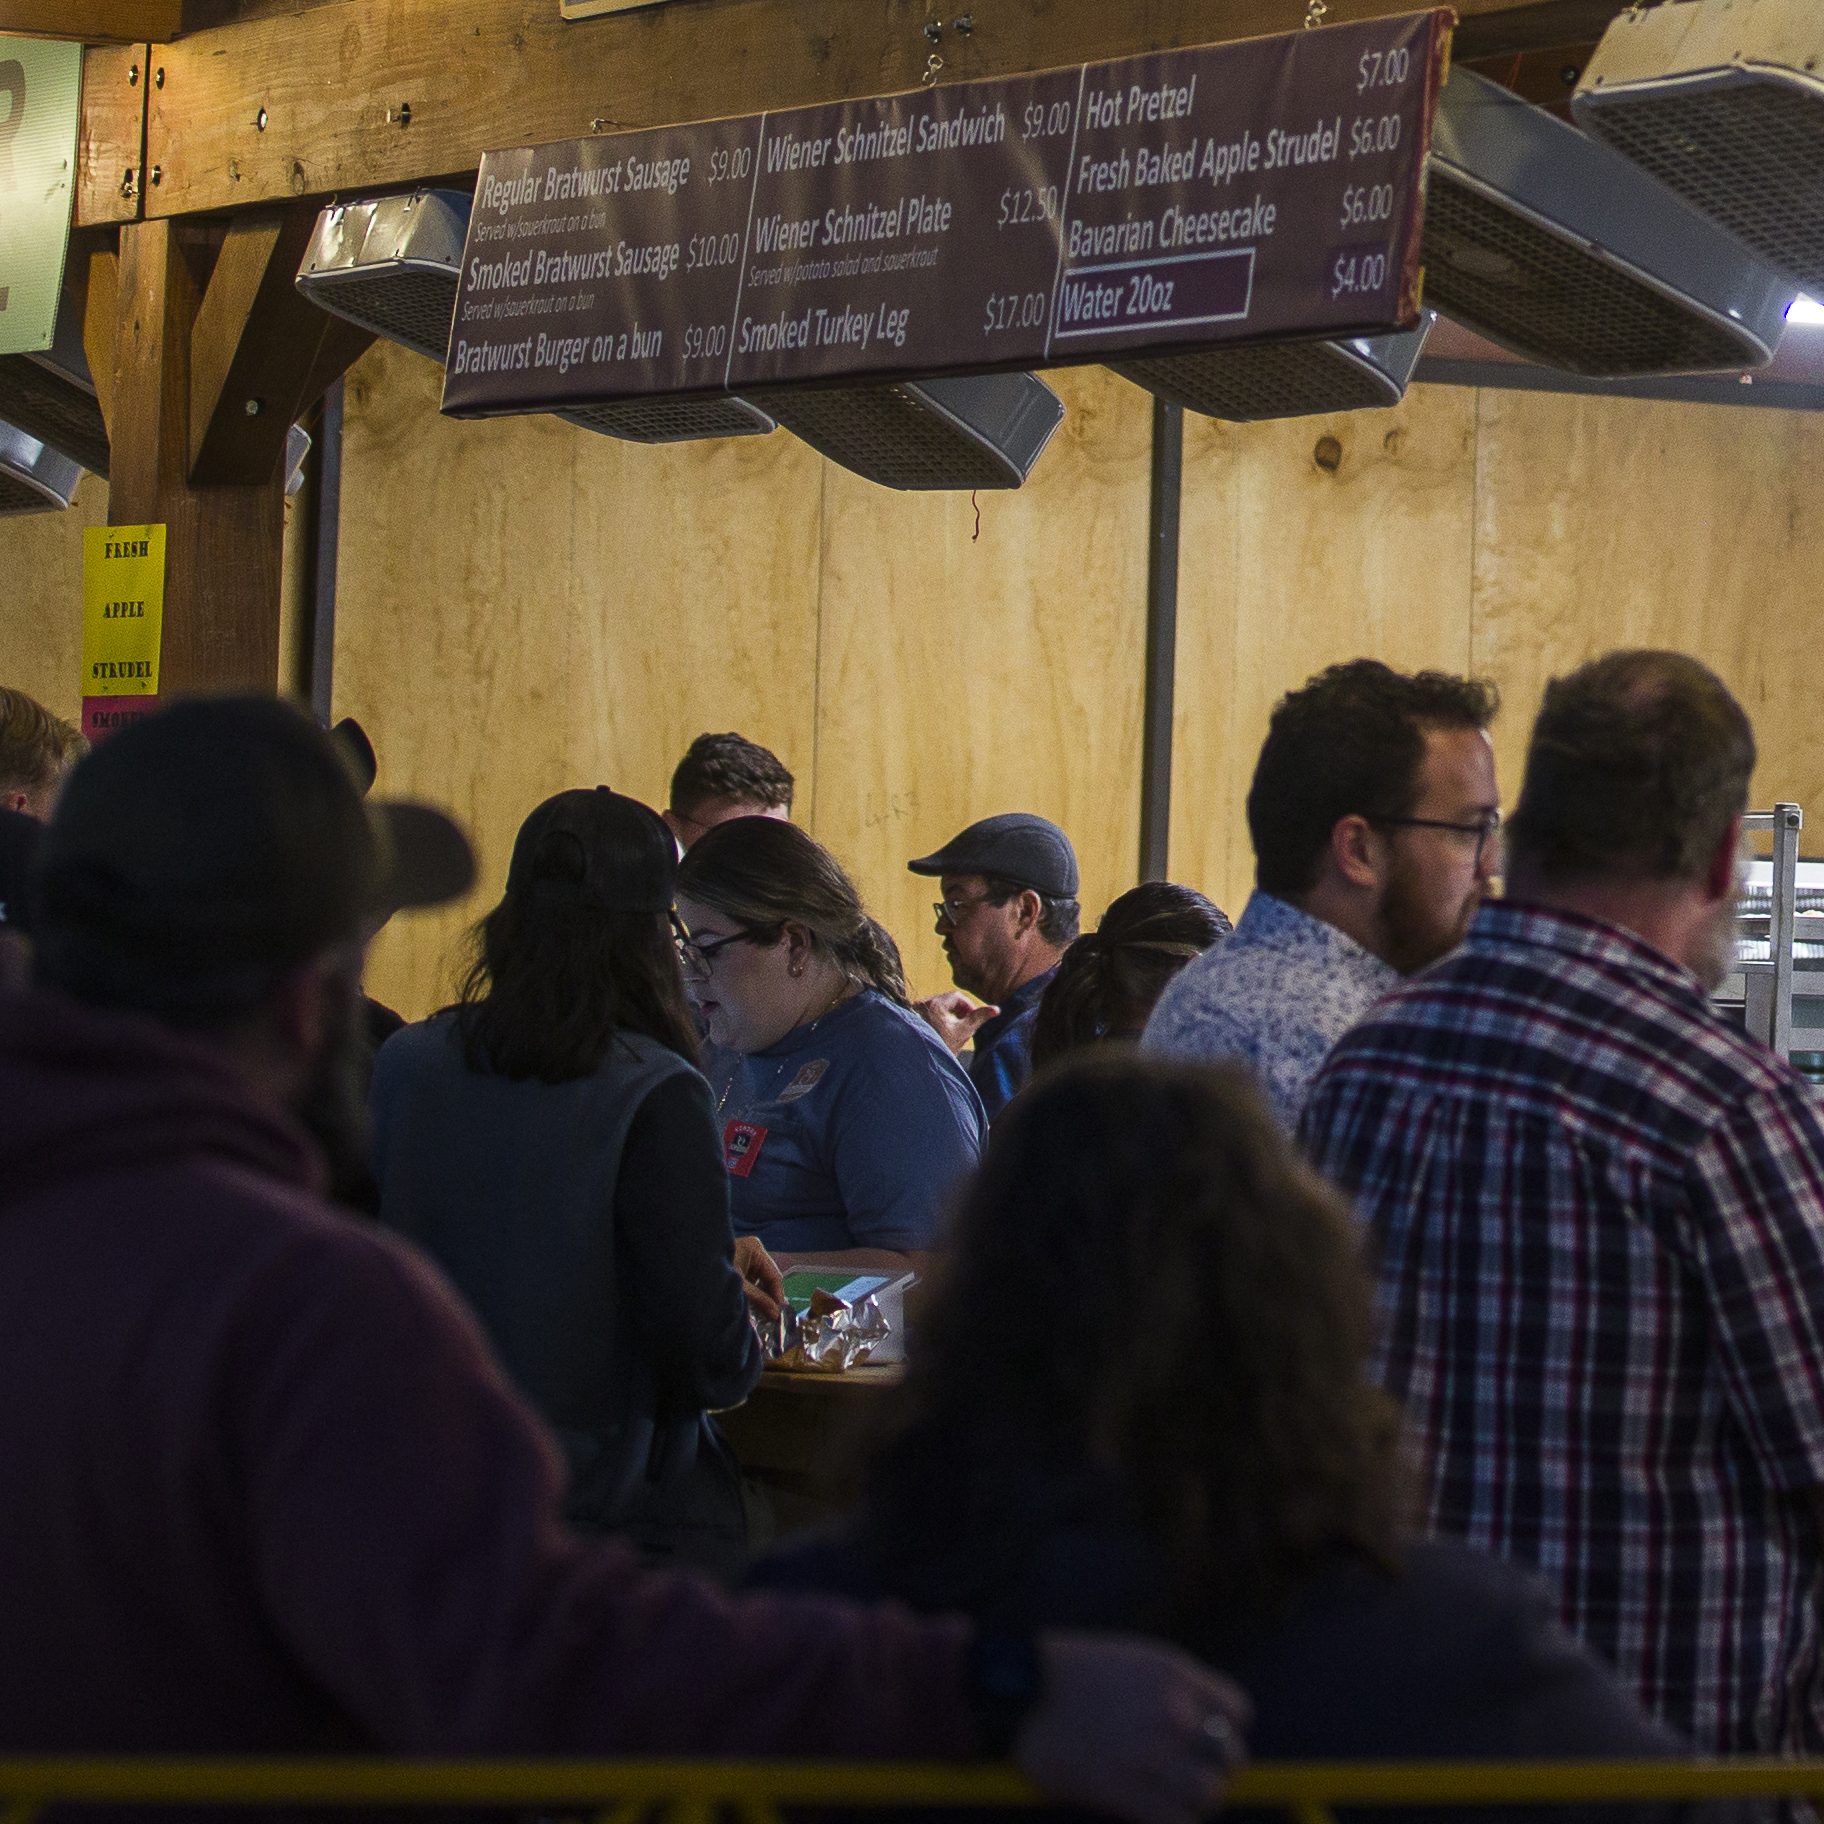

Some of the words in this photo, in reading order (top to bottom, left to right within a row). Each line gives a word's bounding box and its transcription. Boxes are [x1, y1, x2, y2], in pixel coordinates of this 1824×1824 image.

[1086, 90, 1123, 129] Hot
[1126, 74, 1197, 125] Pretzel
[1357, 48, 1410, 95] $7.00
[767, 133, 832, 173] Wiener
[834, 115, 915, 165] Schnitzel
[916, 102, 1006, 152] Sandwich
[1022, 100, 1071, 141] $9.00
[1078, 149, 1130, 194] Fresh
[1134, 138, 1198, 186] Baked
[1199, 130, 1260, 186] Apple
[1264, 115, 1342, 170] Strudel
[1348, 114, 1401, 159] $6.00
[482, 169, 542, 215] Regular
[544, 161, 621, 201] Bratwurst
[624, 156, 690, 195] Sausage
[708, 147, 750, 186] $9.00
[475, 220, 506, 243] Served
[755, 214, 819, 253] Wiener
[822, 196, 904, 246] Schnitzel
[907, 195, 952, 235] Plate
[998, 185, 1058, 231] $12.50
[1068, 213, 1154, 258] Bavarian
[1159, 193, 1277, 248] Cheesecake
[1340, 183, 1393, 231] $6.00
[467, 250, 532, 291] Smoked
[534, 244, 613, 285] Bratwurst
[615, 241, 680, 280] Sausage
[686, 233, 739, 273] $10.00
[747, 261, 783, 287] Served
[1063, 281, 1123, 322] Water
[1126, 275, 1174, 316] 20oz
[1332, 252, 1385, 301] $4.00
[462, 297, 492, 321] Served
[738, 308, 812, 353] Smoked
[815, 305, 876, 349] Turkey
[877, 302, 910, 347] Leg
[984, 292, 1045, 336] $17.00
[455, 333, 532, 374] Bratwurst
[534, 333, 590, 374] Burger
[592, 336, 613, 364] on
[616, 335, 628, 360] a
[631, 322, 663, 359] bun
[683, 324, 727, 363] $9.00
[104, 541, 149, 559] FRESH
[103, 601, 144, 618] APPLE
[92, 661, 152, 679] STRUDEL
